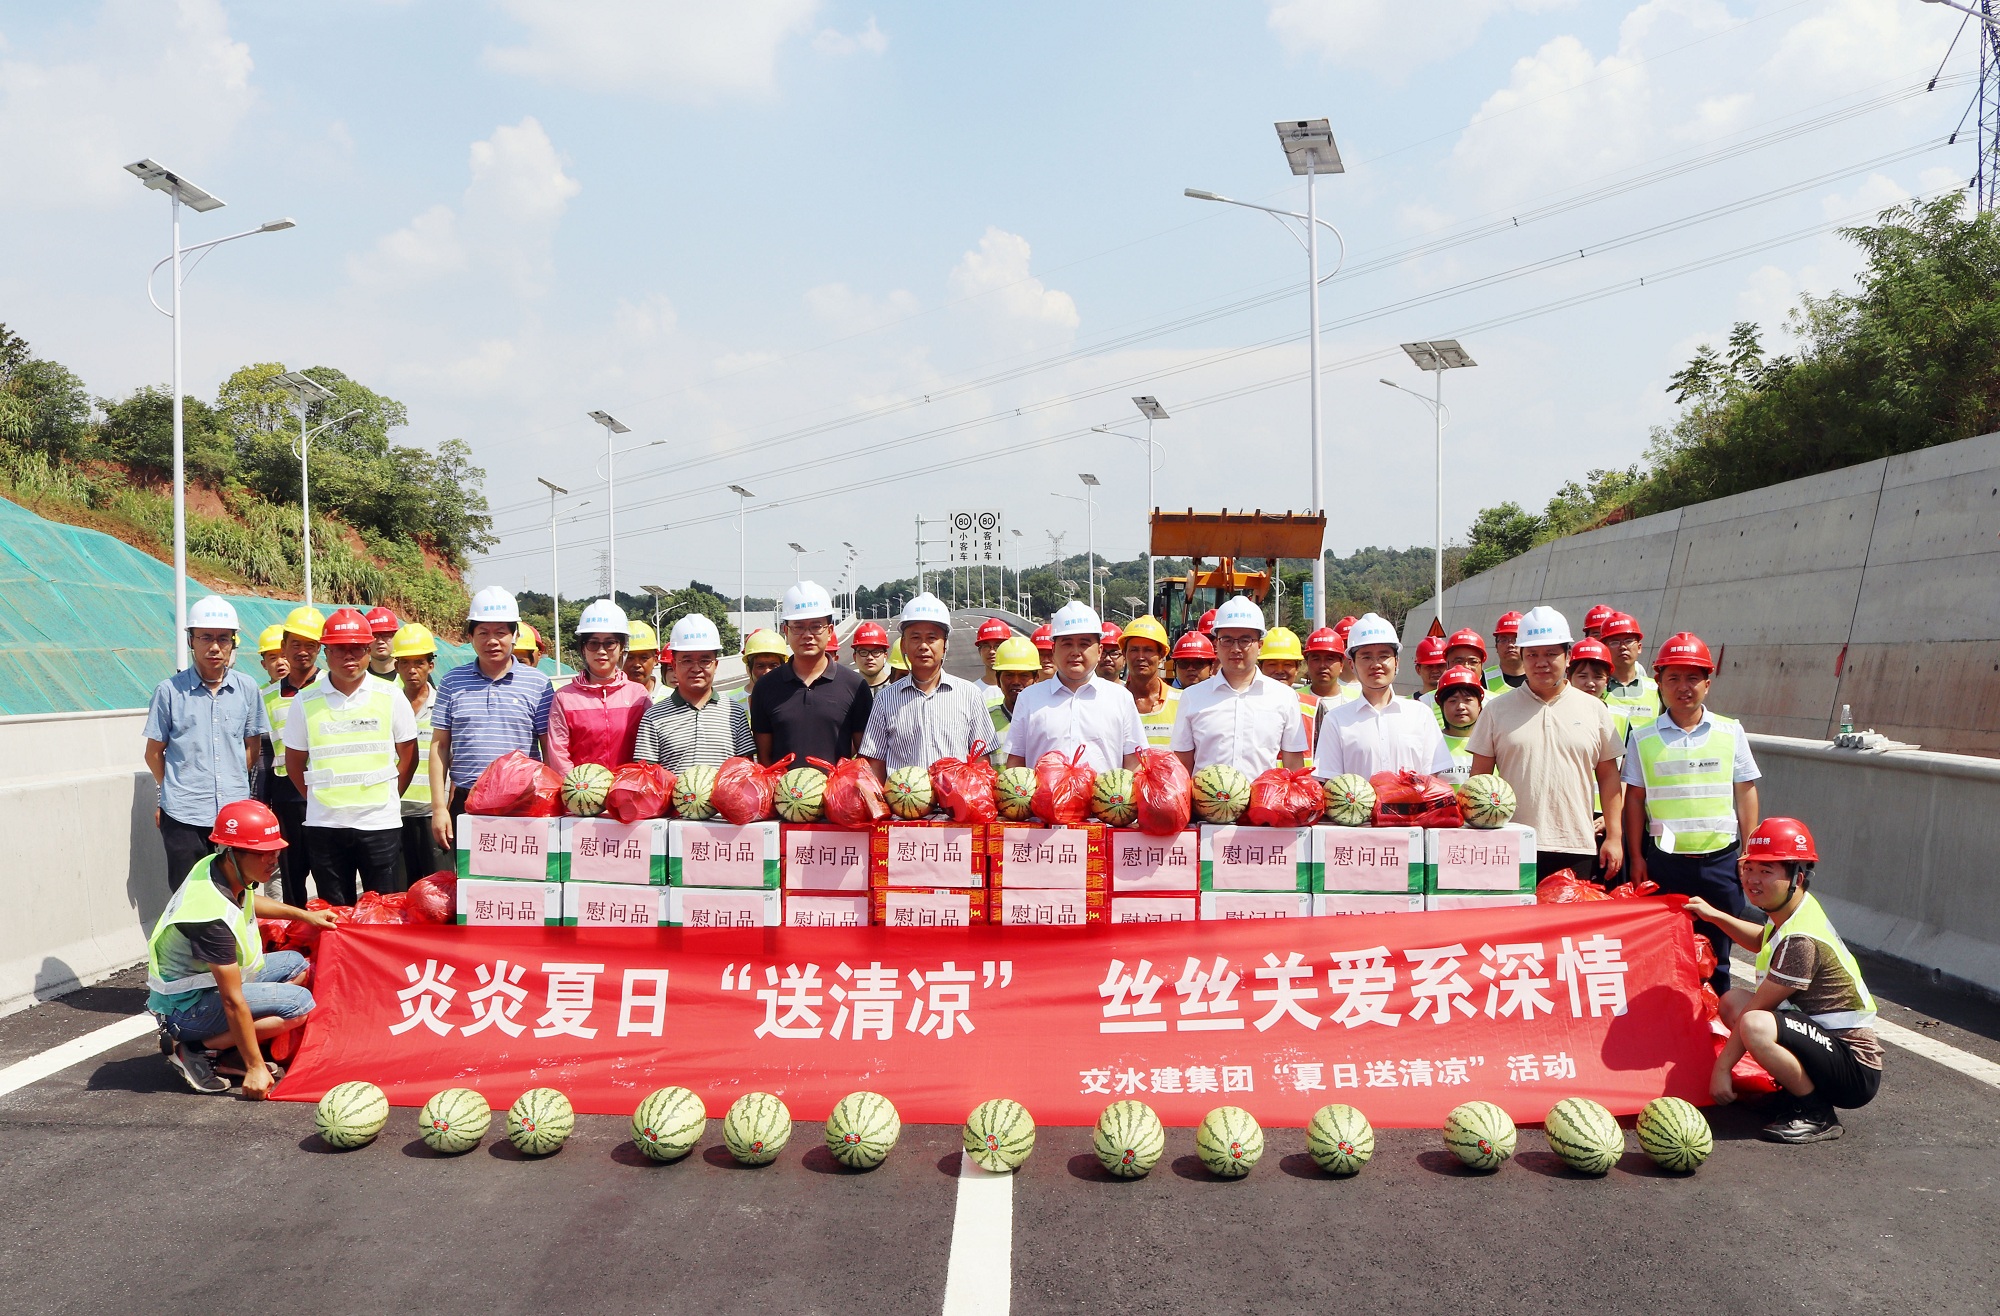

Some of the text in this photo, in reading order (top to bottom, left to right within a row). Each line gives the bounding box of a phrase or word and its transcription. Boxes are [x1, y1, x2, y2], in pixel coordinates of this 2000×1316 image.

[958, 517, 969, 526] 80
[982, 517, 993, 526] 80
[959, 532, 968, 561] 小客车
[983, 531, 992, 560] 客货车
[479, 832, 539, 856] 慰问品
[579, 837, 642, 860] 慰问品
[690, 841, 755, 862] 慰问品
[897, 841, 962, 863] 慰问品
[1012, 842, 1077, 864] 慰问品
[1221, 844, 1288, 866] 慰问品
[794, 844, 860, 867] 慰问品
[1121, 845, 1188, 868] 慰问品
[1333, 846, 1400, 867] 慰问品
[1447, 845, 1511, 866] 慰问品
[475, 900, 537, 922] 慰问品
[586, 901, 649, 924] 慰问品
[691, 909, 754, 927] 慰问品
[894, 906, 959, 927] 慰问品
[1010, 903, 1077, 924] 慰问品
[1098, 934, 1630, 1034] 丝丝关爱系深情
[1784, 1017, 1807, 1036] NEW
